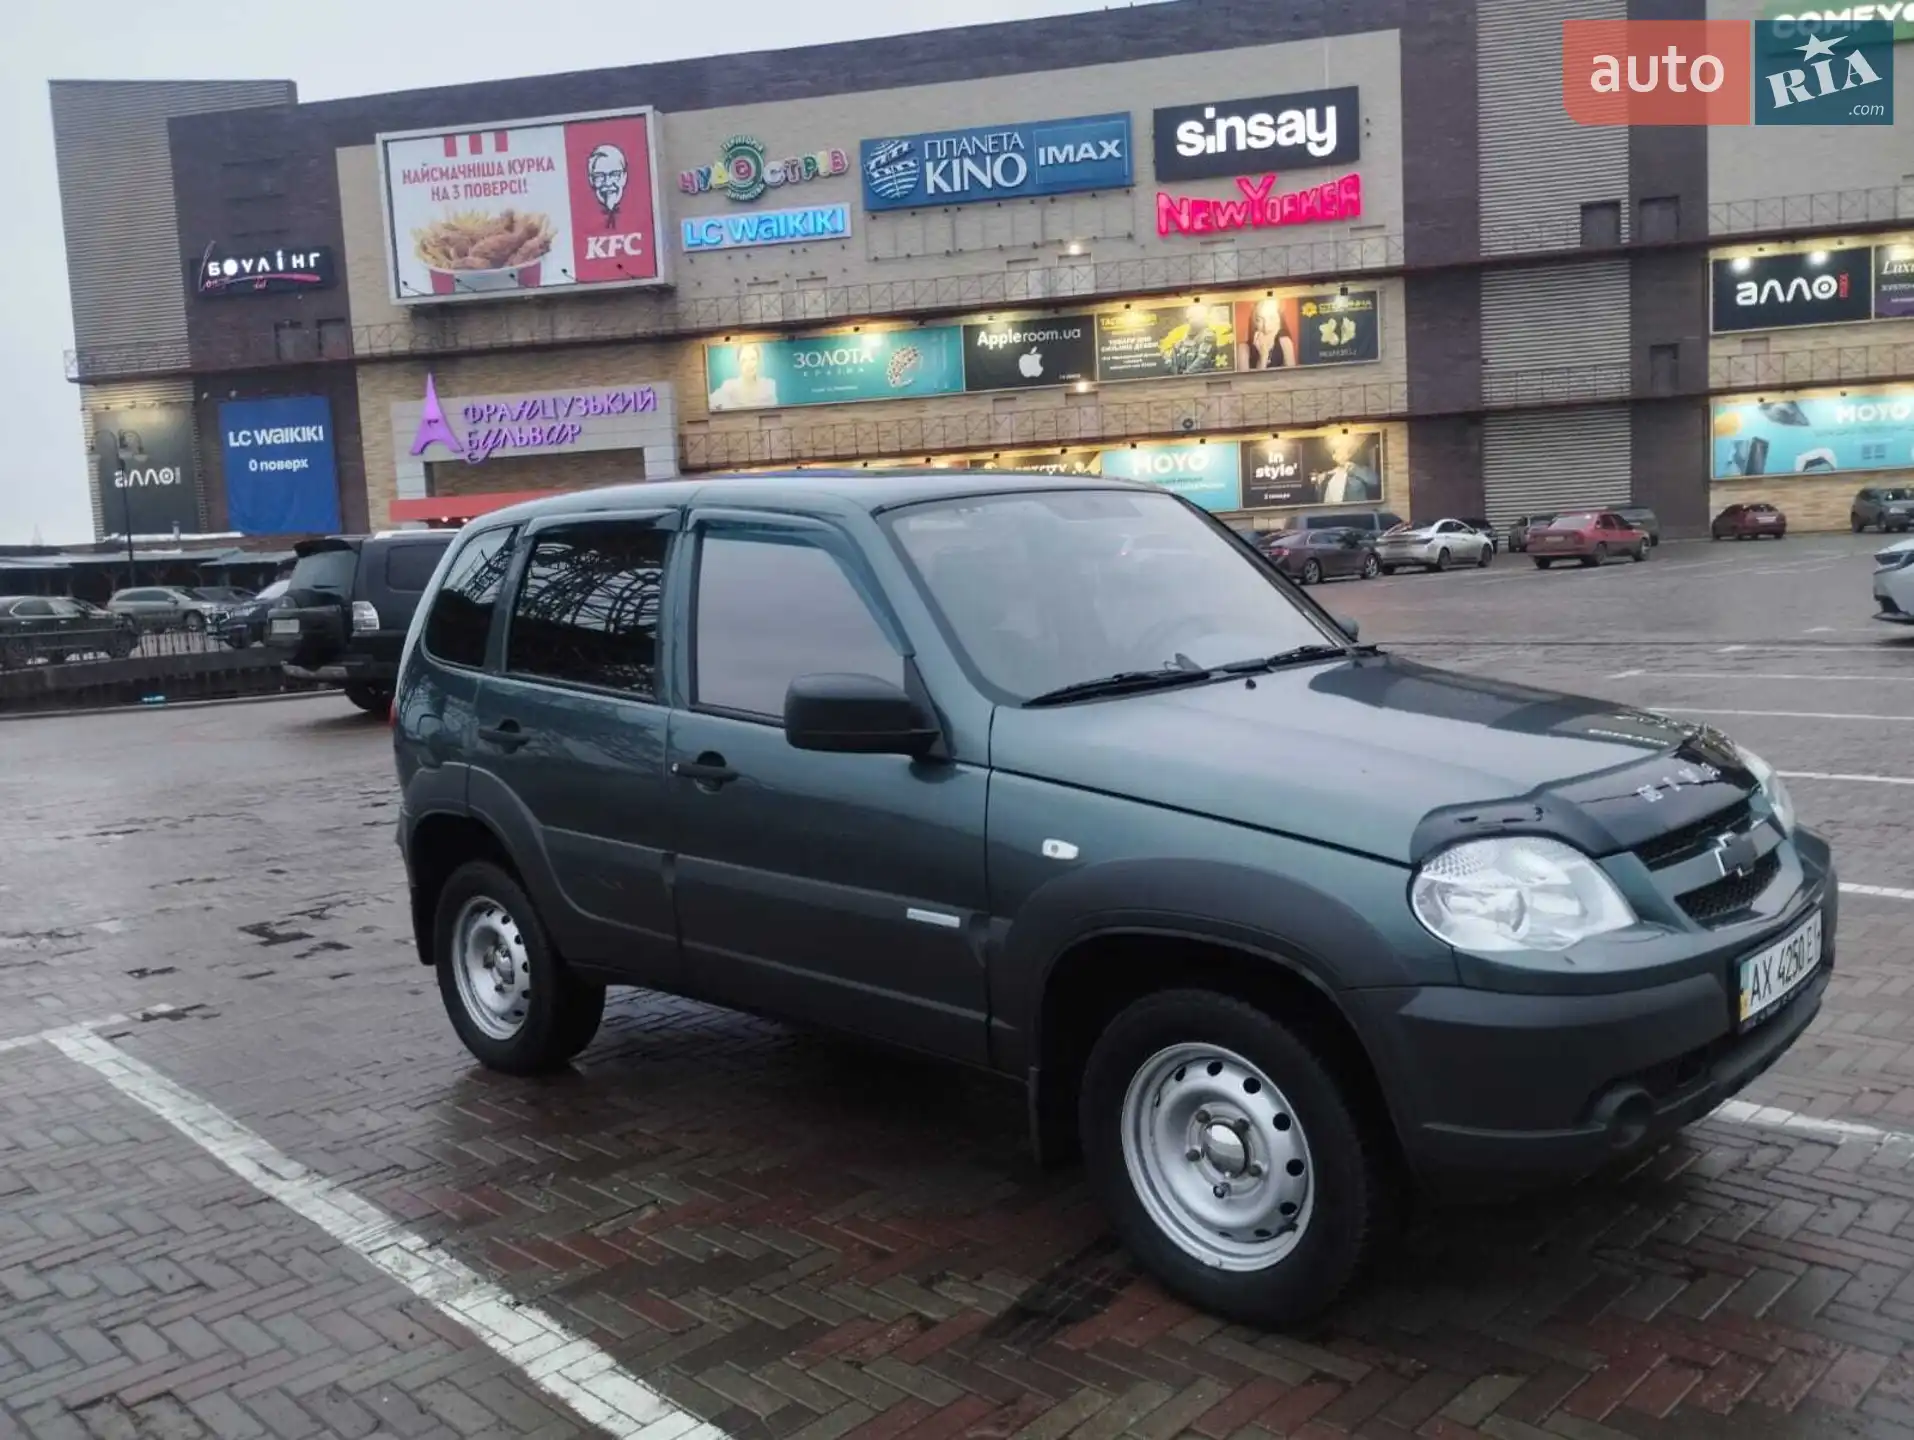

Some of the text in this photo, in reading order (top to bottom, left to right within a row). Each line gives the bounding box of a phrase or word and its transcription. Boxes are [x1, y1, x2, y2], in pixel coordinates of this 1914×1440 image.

[1176, 105, 1337, 157] sinsay
[402, 157, 556, 185] НАЙСМАЧНІША КУРКА
[925, 139, 1123, 194] KINO IMAX
[430, 179, 528, 201] НА 3 ПОВЕРСІ!
[585, 232, 643, 260] KFC
[685, 219, 723, 247] LC
[207, 250, 321, 277] БОУЛІНГ
[977, 327, 1081, 350] Appleroom.ua
[793, 348, 875, 369] ЗОЛОТА
[464, 386, 658, 424] ФРАНЦУЗЬКИЙ
[1837, 403, 1911, 424] MOYO
[228, 430, 253, 447] LC
[260, 458, 309, 473] поверх
[1750, 956, 1773, 1006] AX
